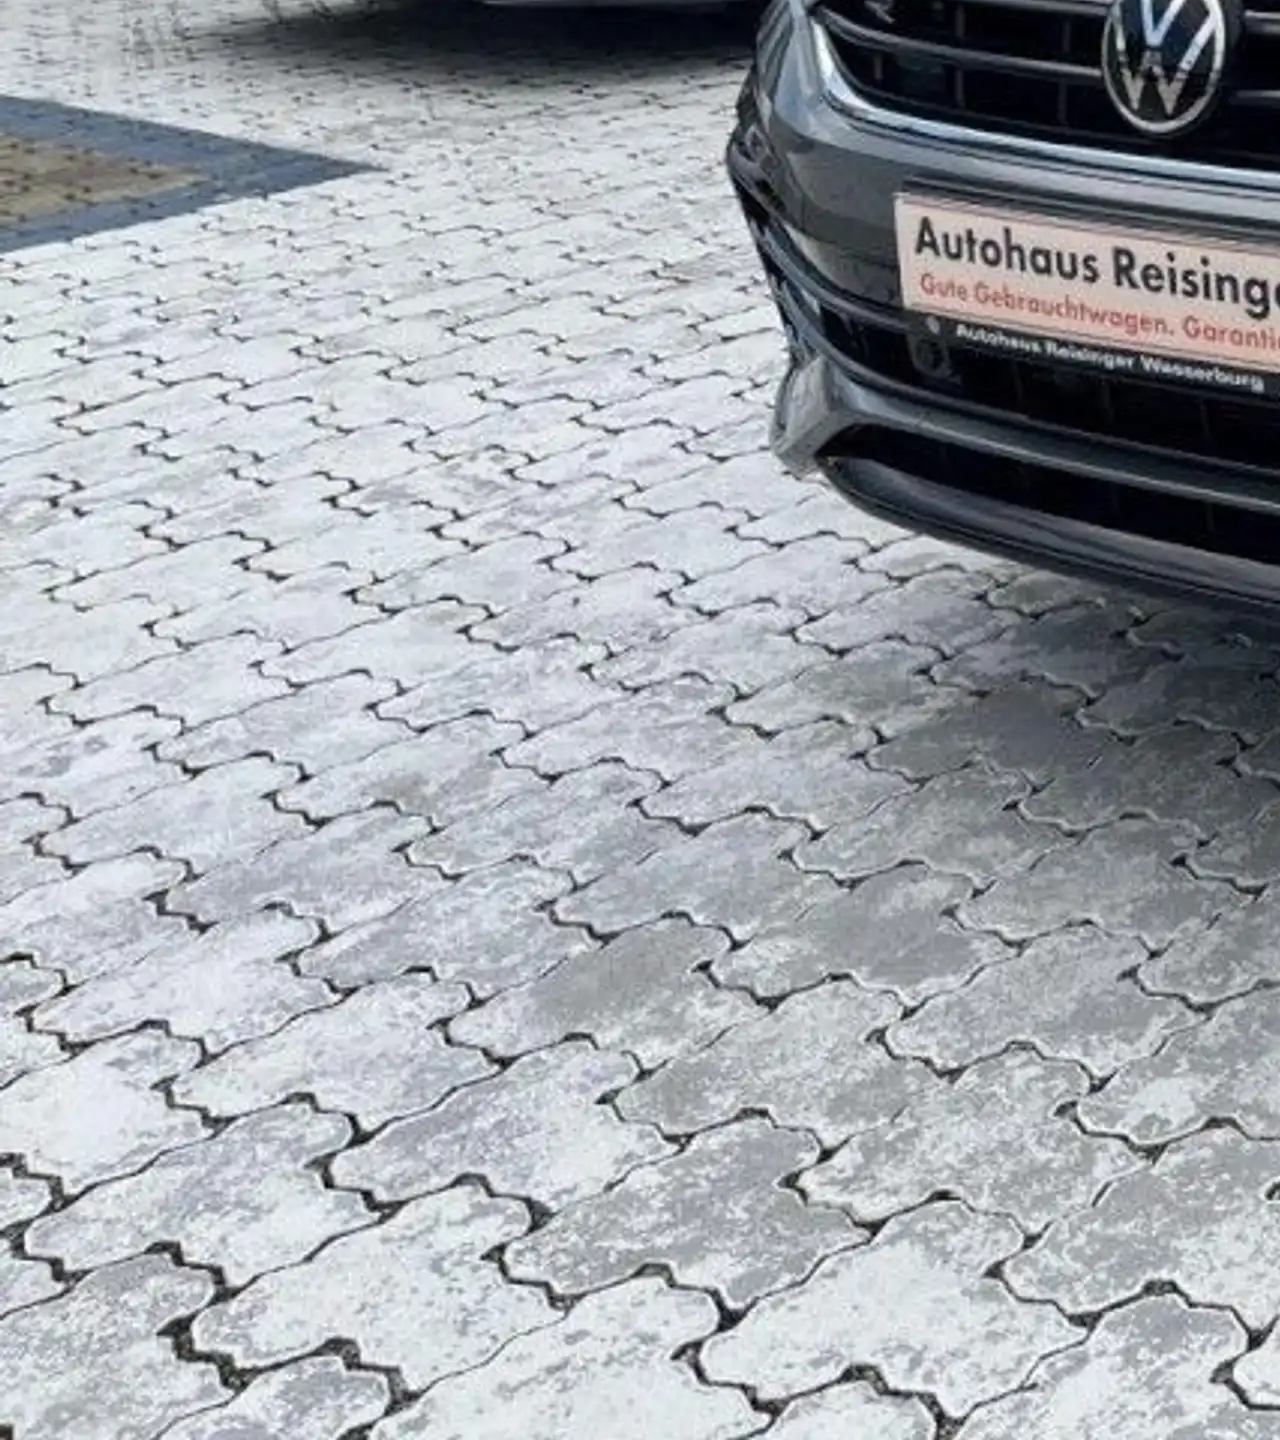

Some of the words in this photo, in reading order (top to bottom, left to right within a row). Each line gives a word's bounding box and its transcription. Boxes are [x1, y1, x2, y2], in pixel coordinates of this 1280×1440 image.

[915, 216, 1099, 284] Autohaus
[920, 272, 967, 302] Gute
[973, 280, 1175, 337] Gebrauchtwagen.
[956, 323, 1042, 354] Autohaus
[1044, 340, 1136, 370] Reisinger
[1140, 355, 1265, 394] Wasserburg
